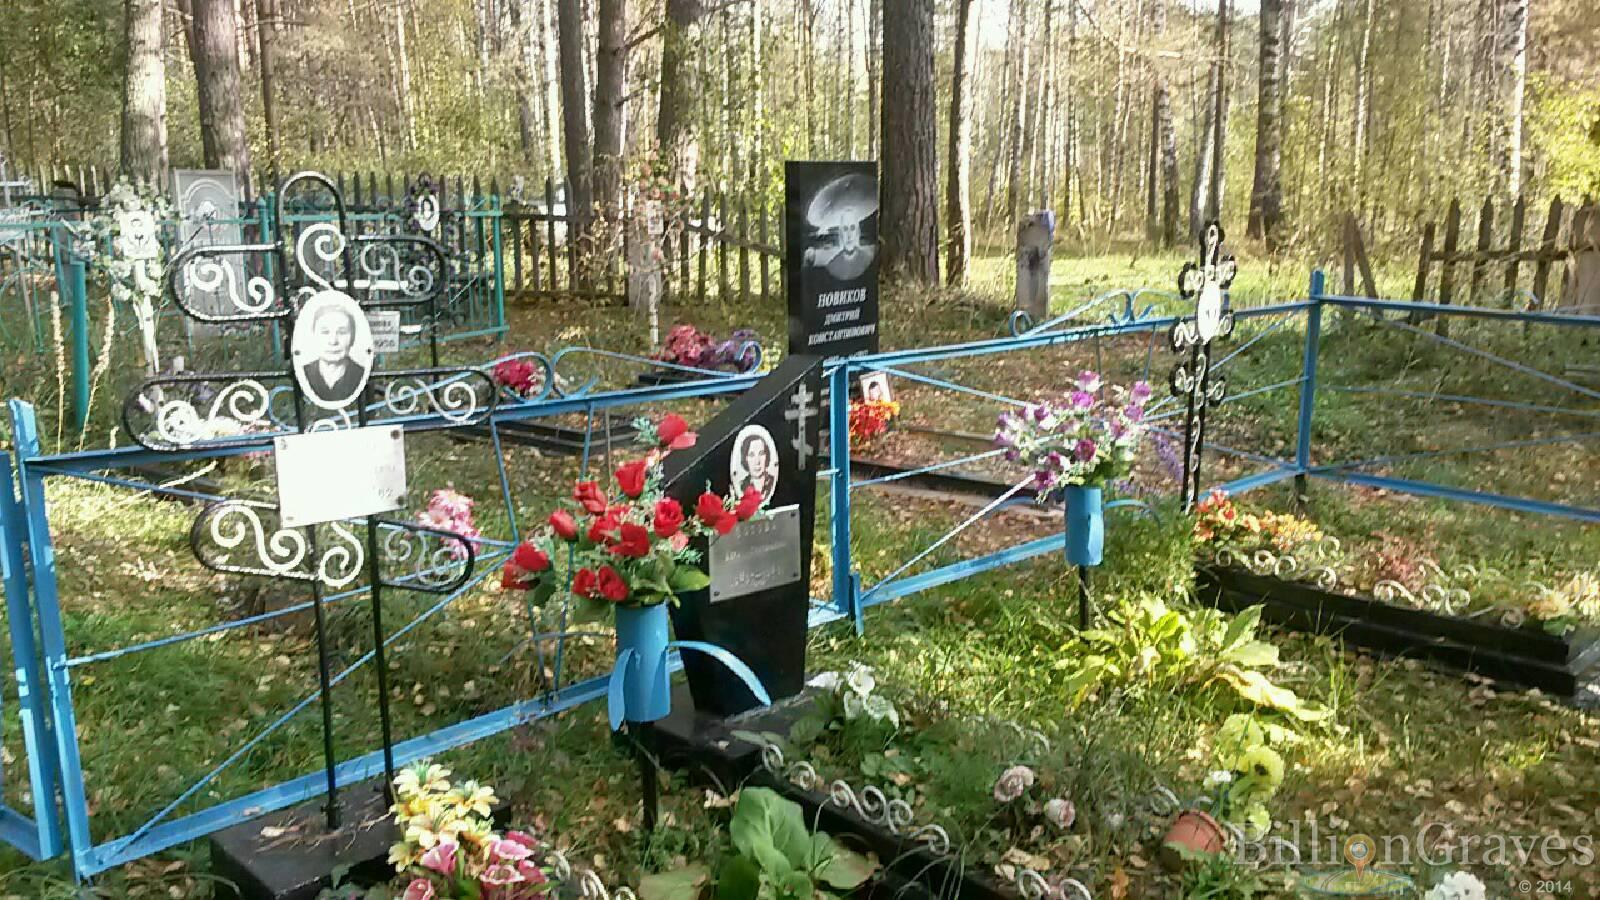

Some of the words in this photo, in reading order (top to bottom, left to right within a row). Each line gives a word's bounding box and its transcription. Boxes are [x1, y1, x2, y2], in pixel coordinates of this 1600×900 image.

[818, 288, 866, 307] НОВИКОВ
[824, 308, 860, 325] ДМИТРИЙ
[808, 324, 876, 345] КОНСТАНТИНОВИЧ
